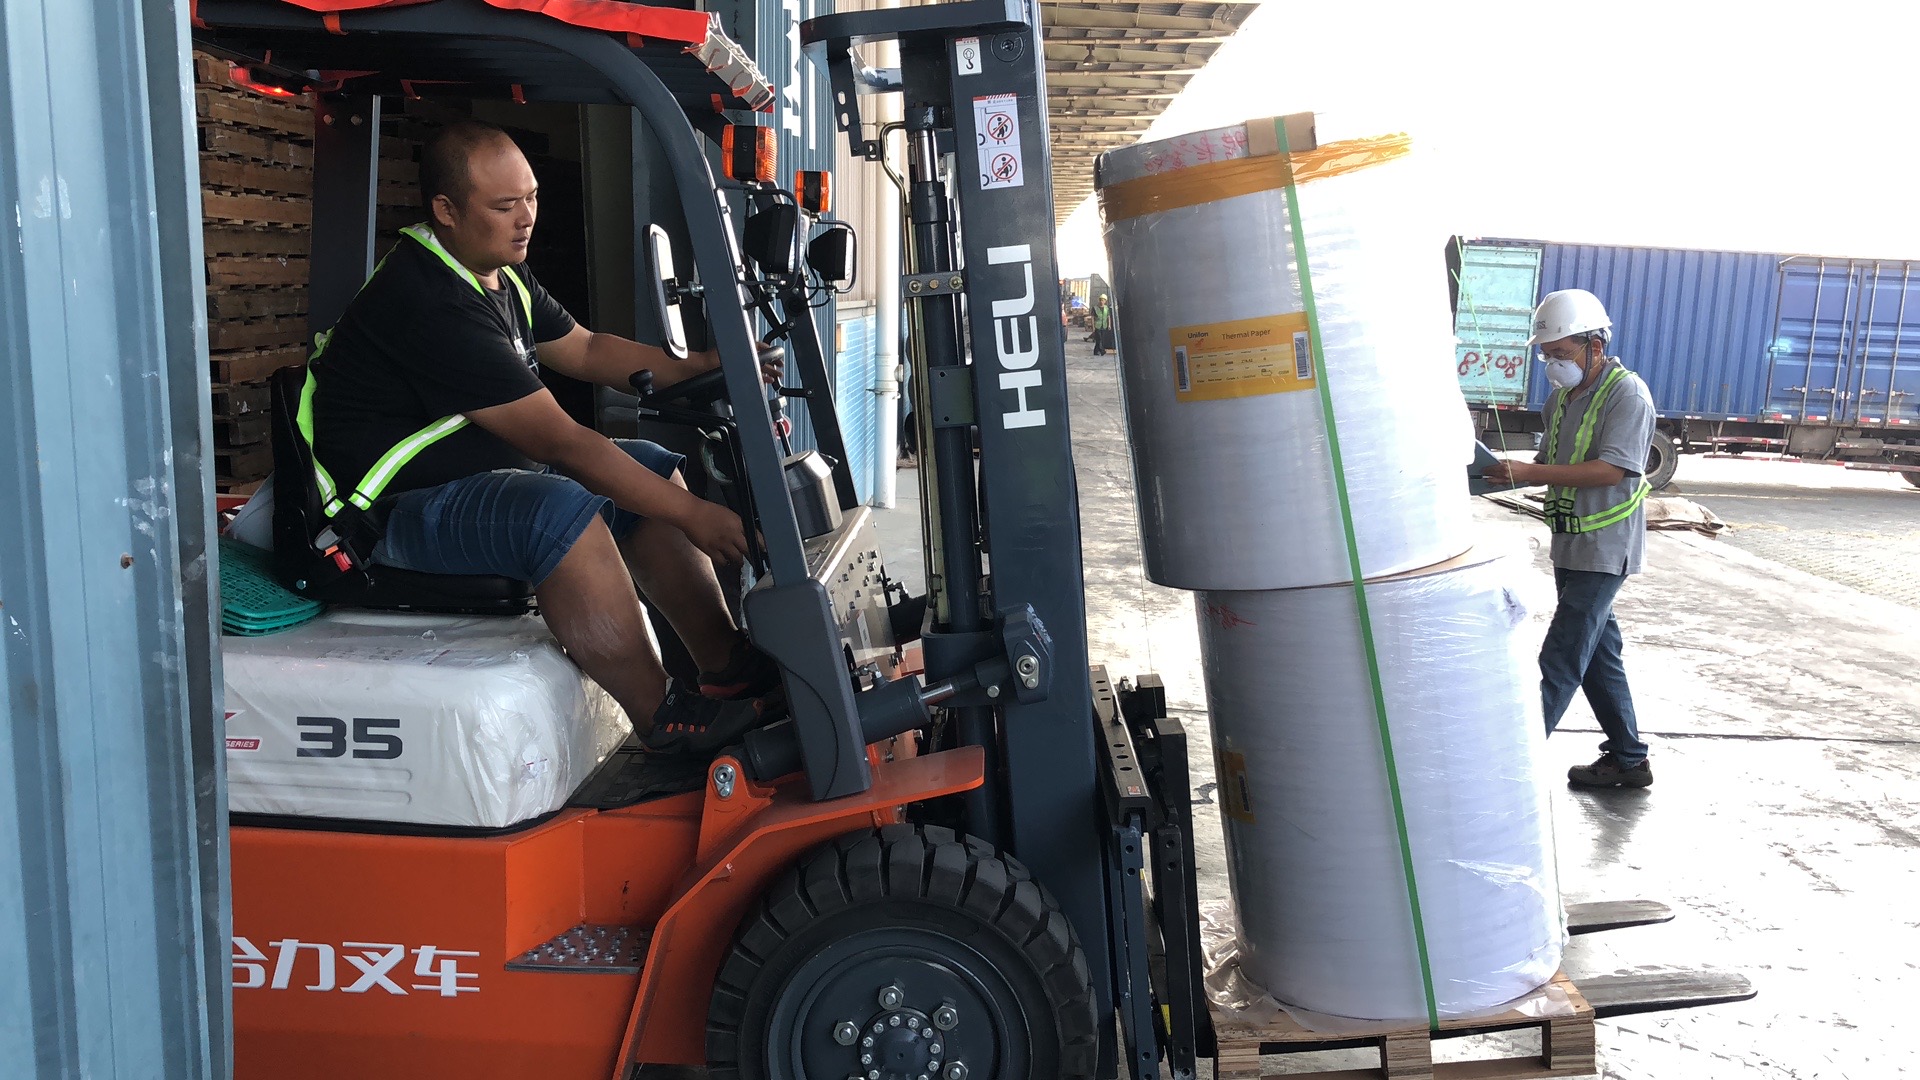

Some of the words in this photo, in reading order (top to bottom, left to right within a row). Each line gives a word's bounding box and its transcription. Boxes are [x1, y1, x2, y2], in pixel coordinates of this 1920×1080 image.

[987, 244, 1046, 430] HELI
[1221, 331, 1250, 340] Thermal
[1250, 329, 1271, 338] Paper
[296, 716, 403, 759] 35
